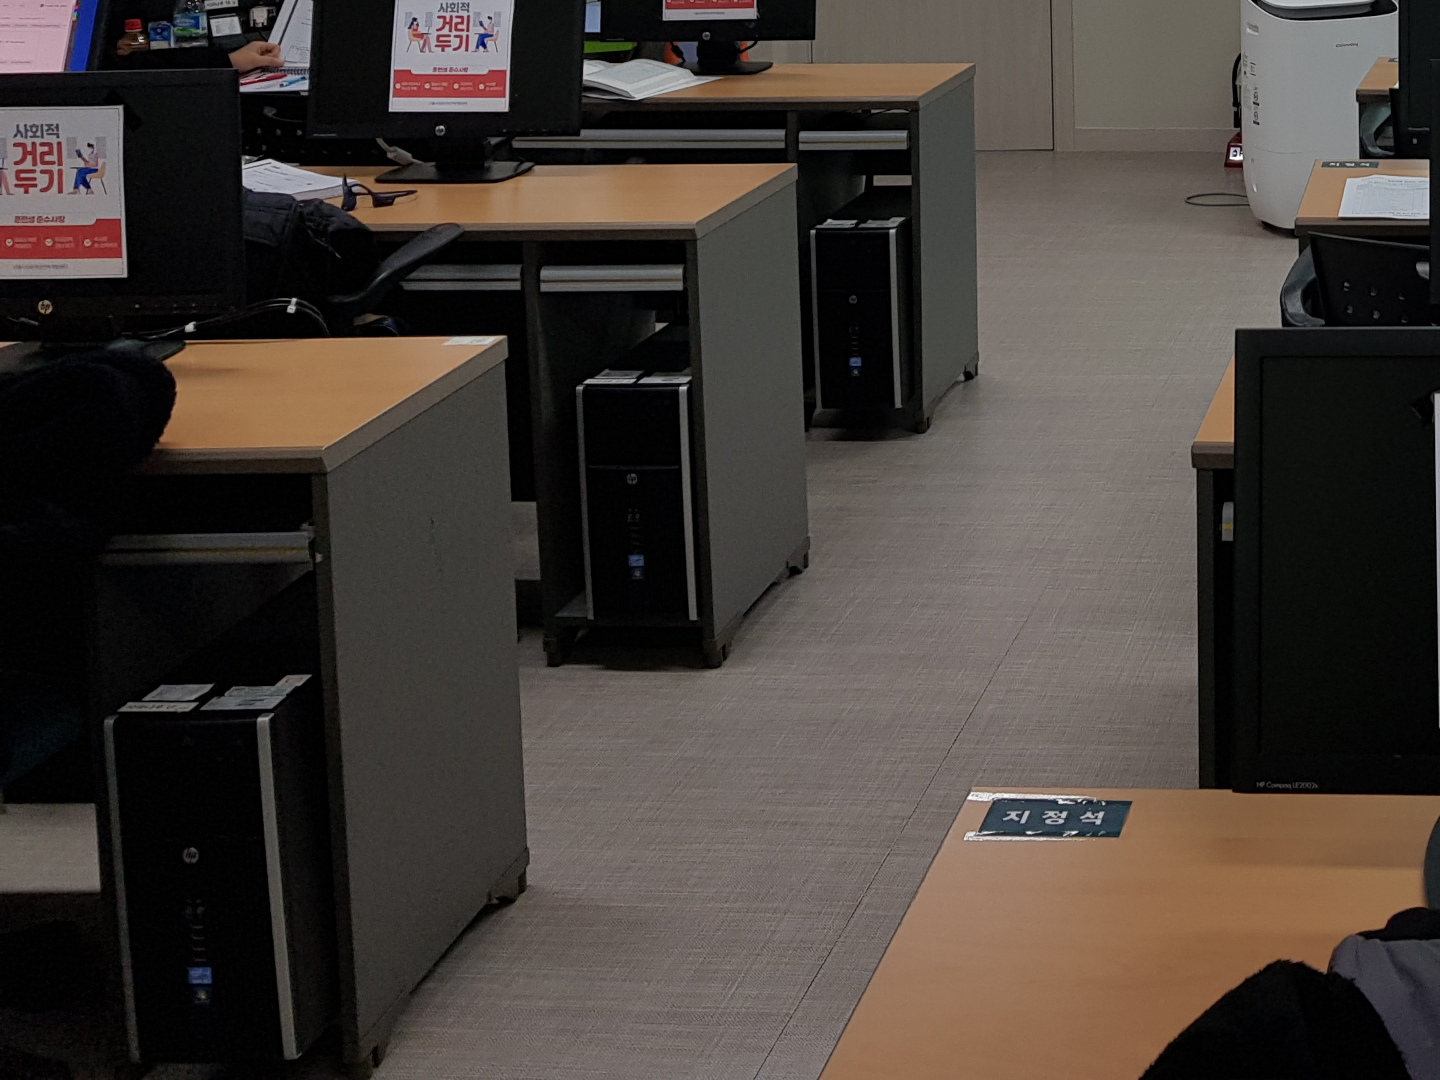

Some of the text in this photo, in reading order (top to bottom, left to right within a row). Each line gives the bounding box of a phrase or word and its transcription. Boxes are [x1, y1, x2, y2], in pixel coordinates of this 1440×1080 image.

[437, 1, 470, 13] 사회적
[435, 15, 470, 33] 거리
[434, 34, 470, 52] 두기
[13, 123, 60, 139] 사회적
[12, 141, 63, 167] 거리
[14, 169, 64, 194] 두기
